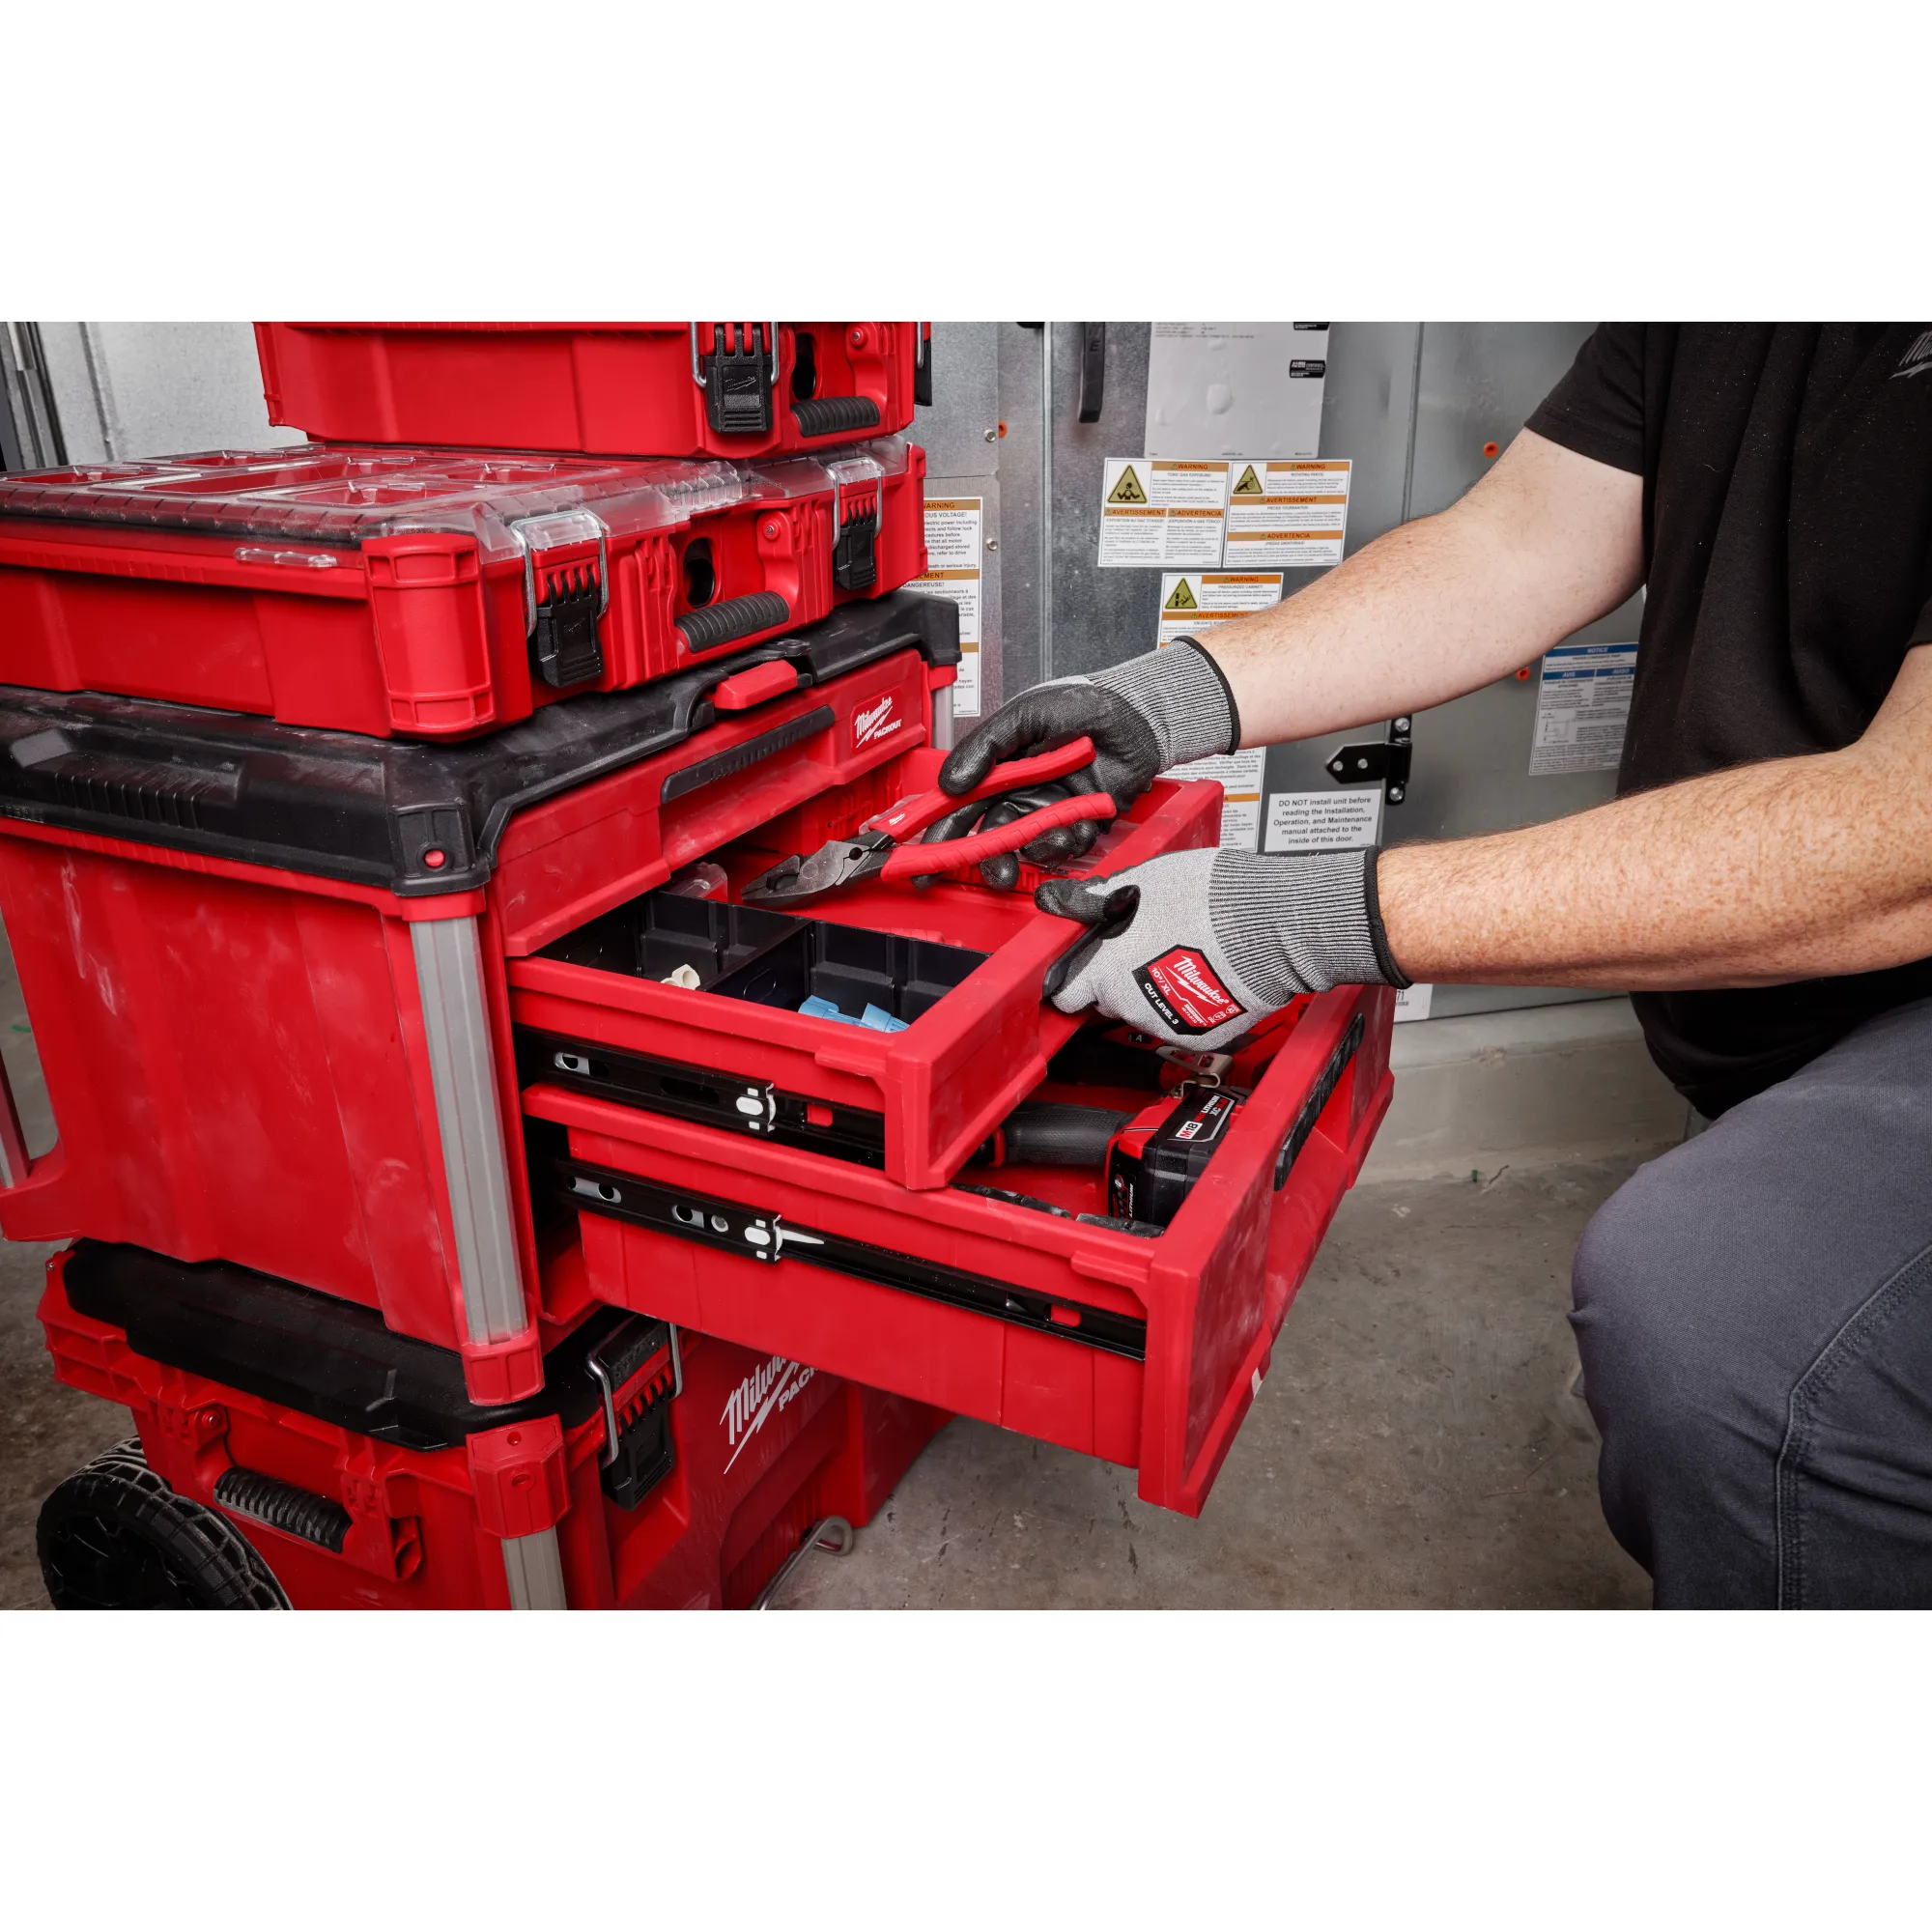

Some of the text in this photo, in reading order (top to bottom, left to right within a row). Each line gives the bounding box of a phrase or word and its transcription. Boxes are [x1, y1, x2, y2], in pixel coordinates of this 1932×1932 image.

[854, 696, 893, 739] Milwaukee
[874, 719, 902, 740] PACKOUT
[1274, 819, 1310, 827] Operation,
[1161, 984, 1172, 995] XL
[1144, 983, 1158, 1001] CUT
[1155, 999, 1175, 1019] LEVEL
[1180, 1122, 1198, 1139] M18
